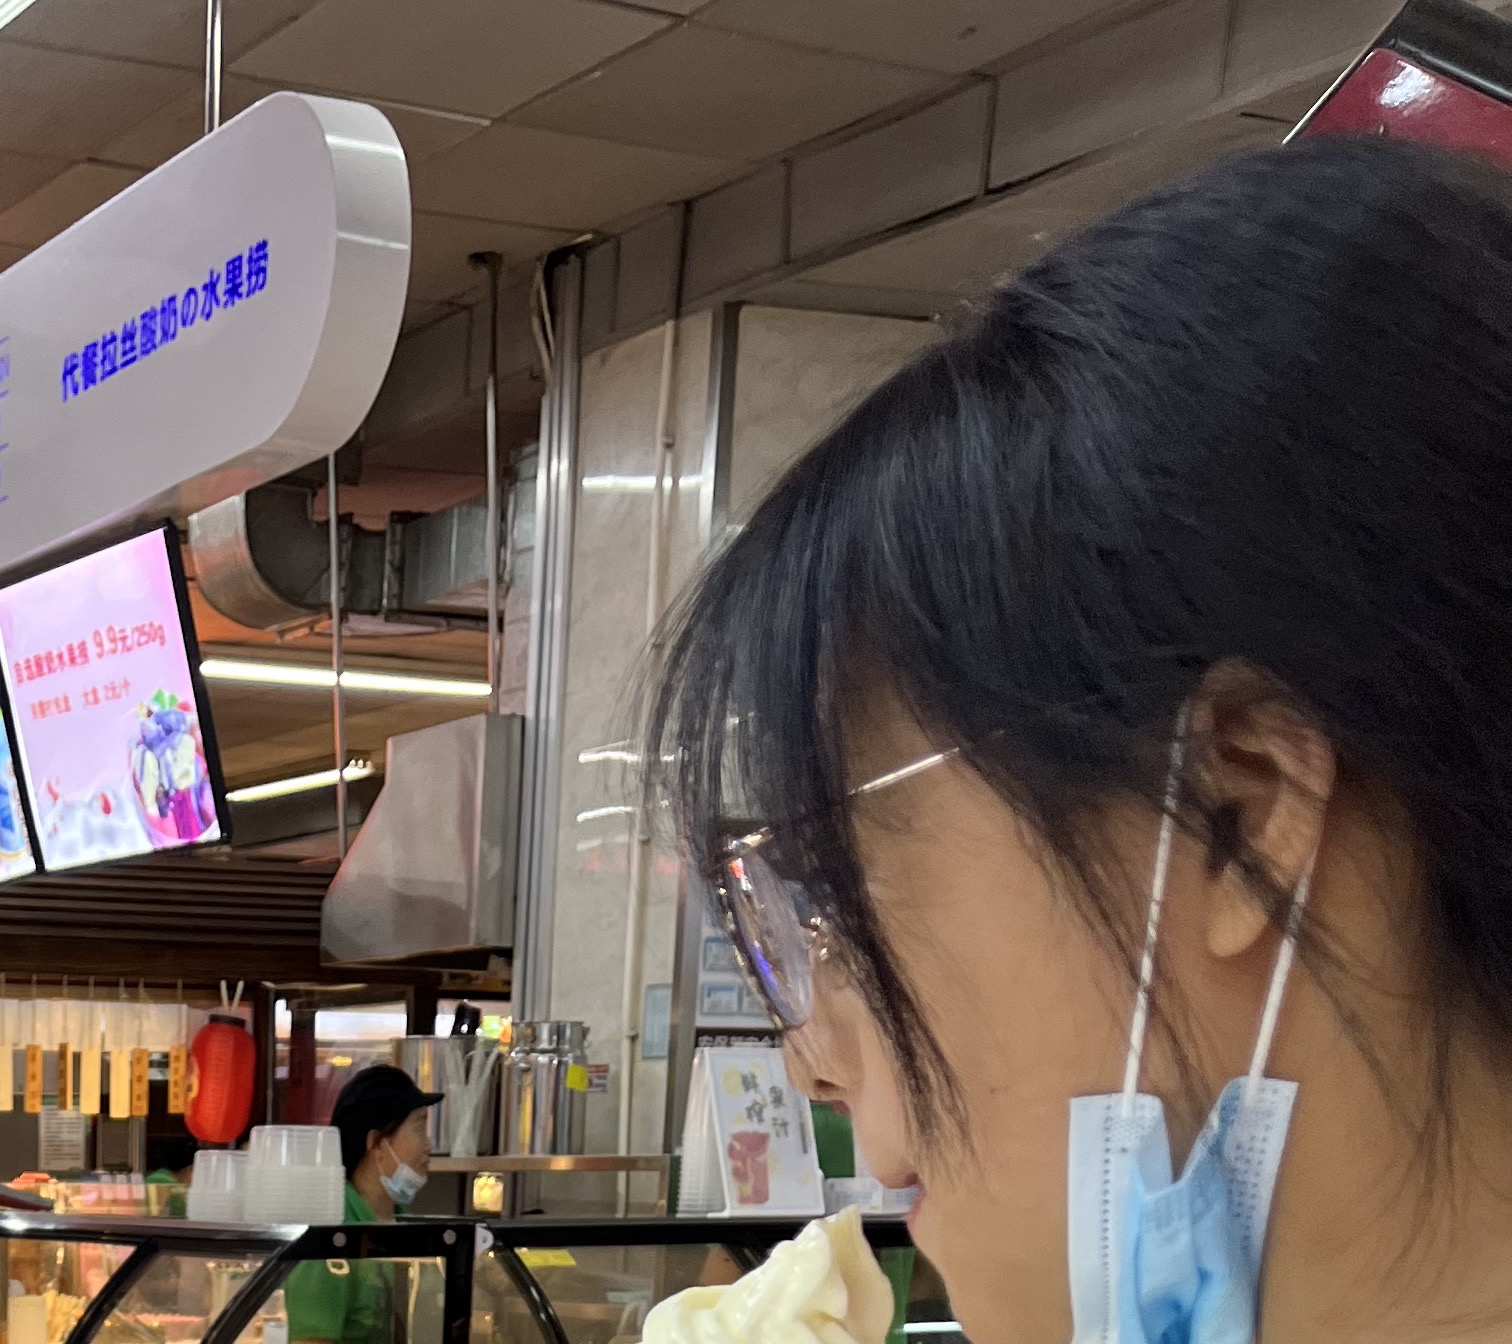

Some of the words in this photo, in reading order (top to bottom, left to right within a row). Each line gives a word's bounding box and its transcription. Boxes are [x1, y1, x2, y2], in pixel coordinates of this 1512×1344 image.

[61, 238, 269, 403] 代餐拉丝酸奶の水果捞
